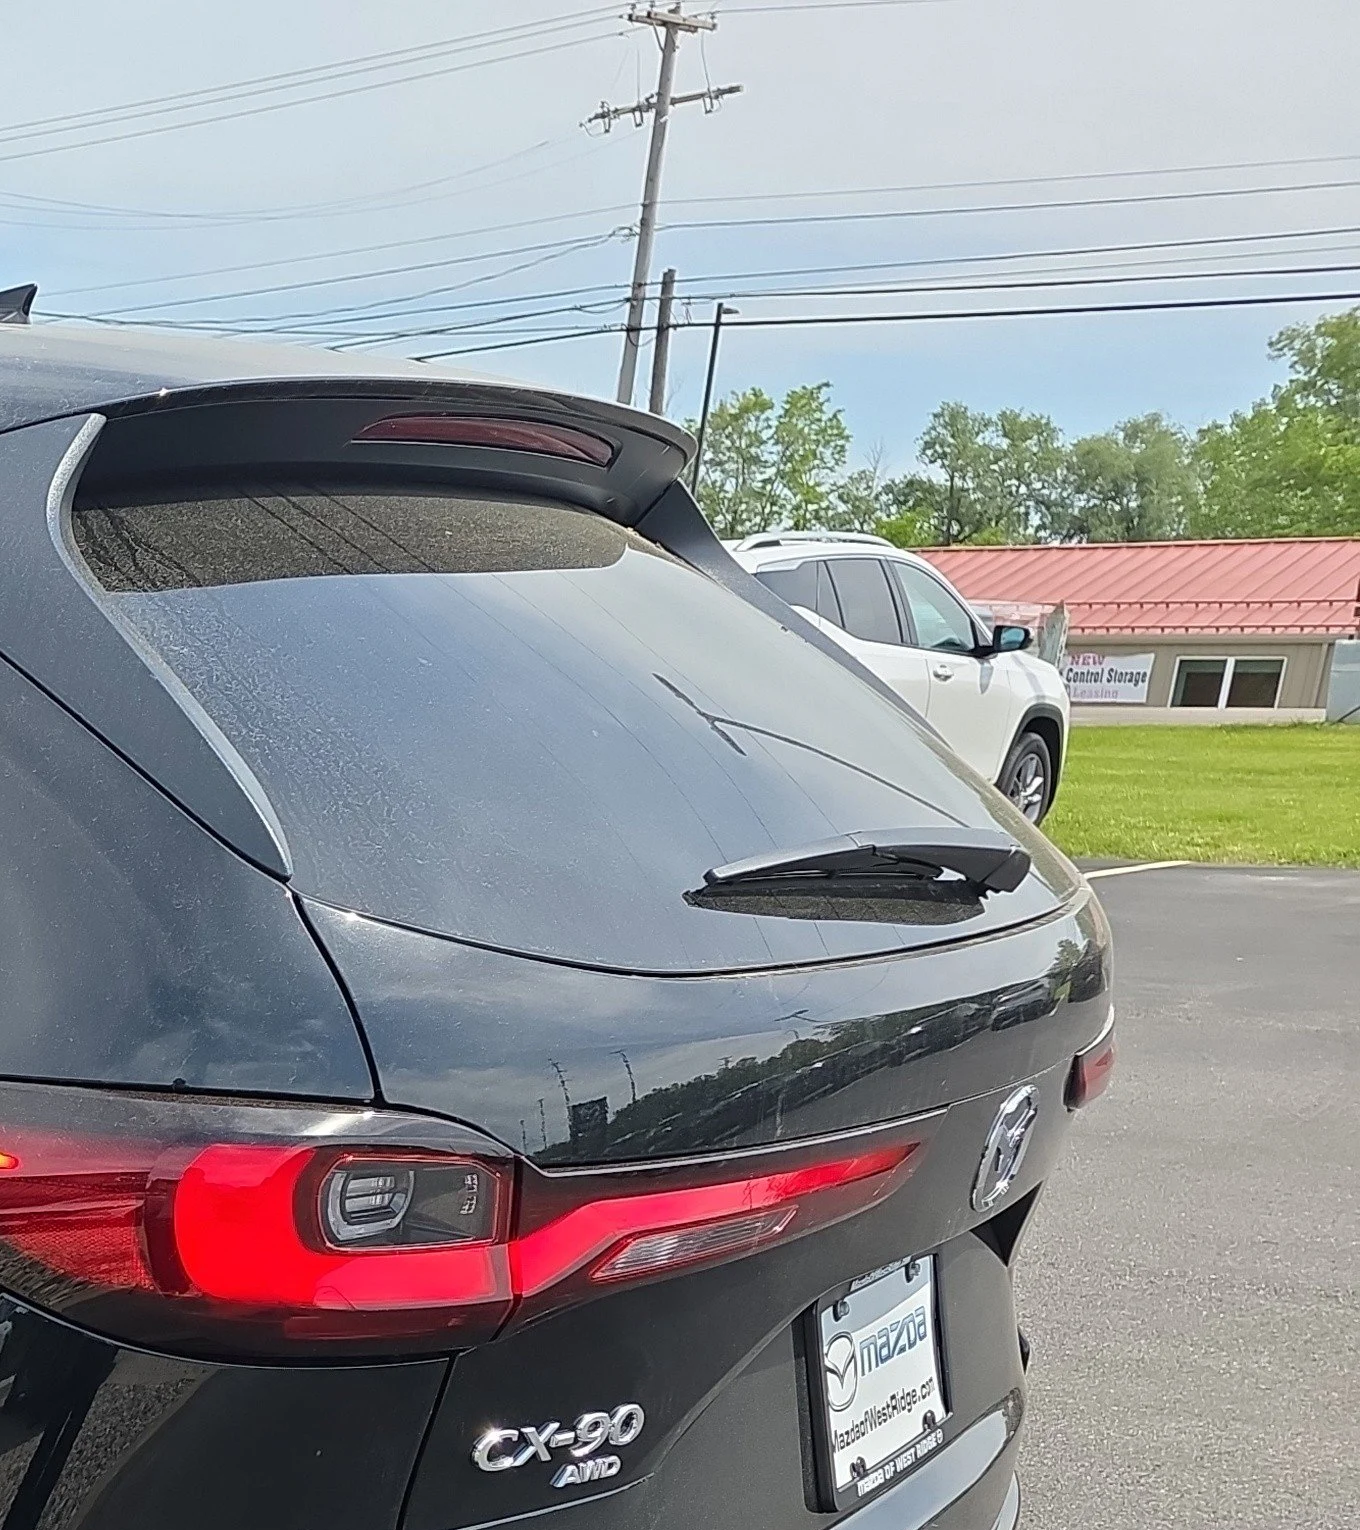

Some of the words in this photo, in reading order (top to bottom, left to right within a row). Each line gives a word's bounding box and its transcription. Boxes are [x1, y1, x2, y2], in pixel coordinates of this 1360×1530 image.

[1069, 654, 1106, 666] NEW
[1066, 667, 1104, 683] Control
[1106, 667, 1147, 687] Storage
[1073, 687, 1119, 699] Leasing
[472, 1403, 645, 1472] CX-90
[883, 1461, 896, 1480] OF
[895, 1447, 916, 1472] WEST
[915, 1434, 939, 1459] RIDGE
[549, 1455, 622, 1488] AWD
